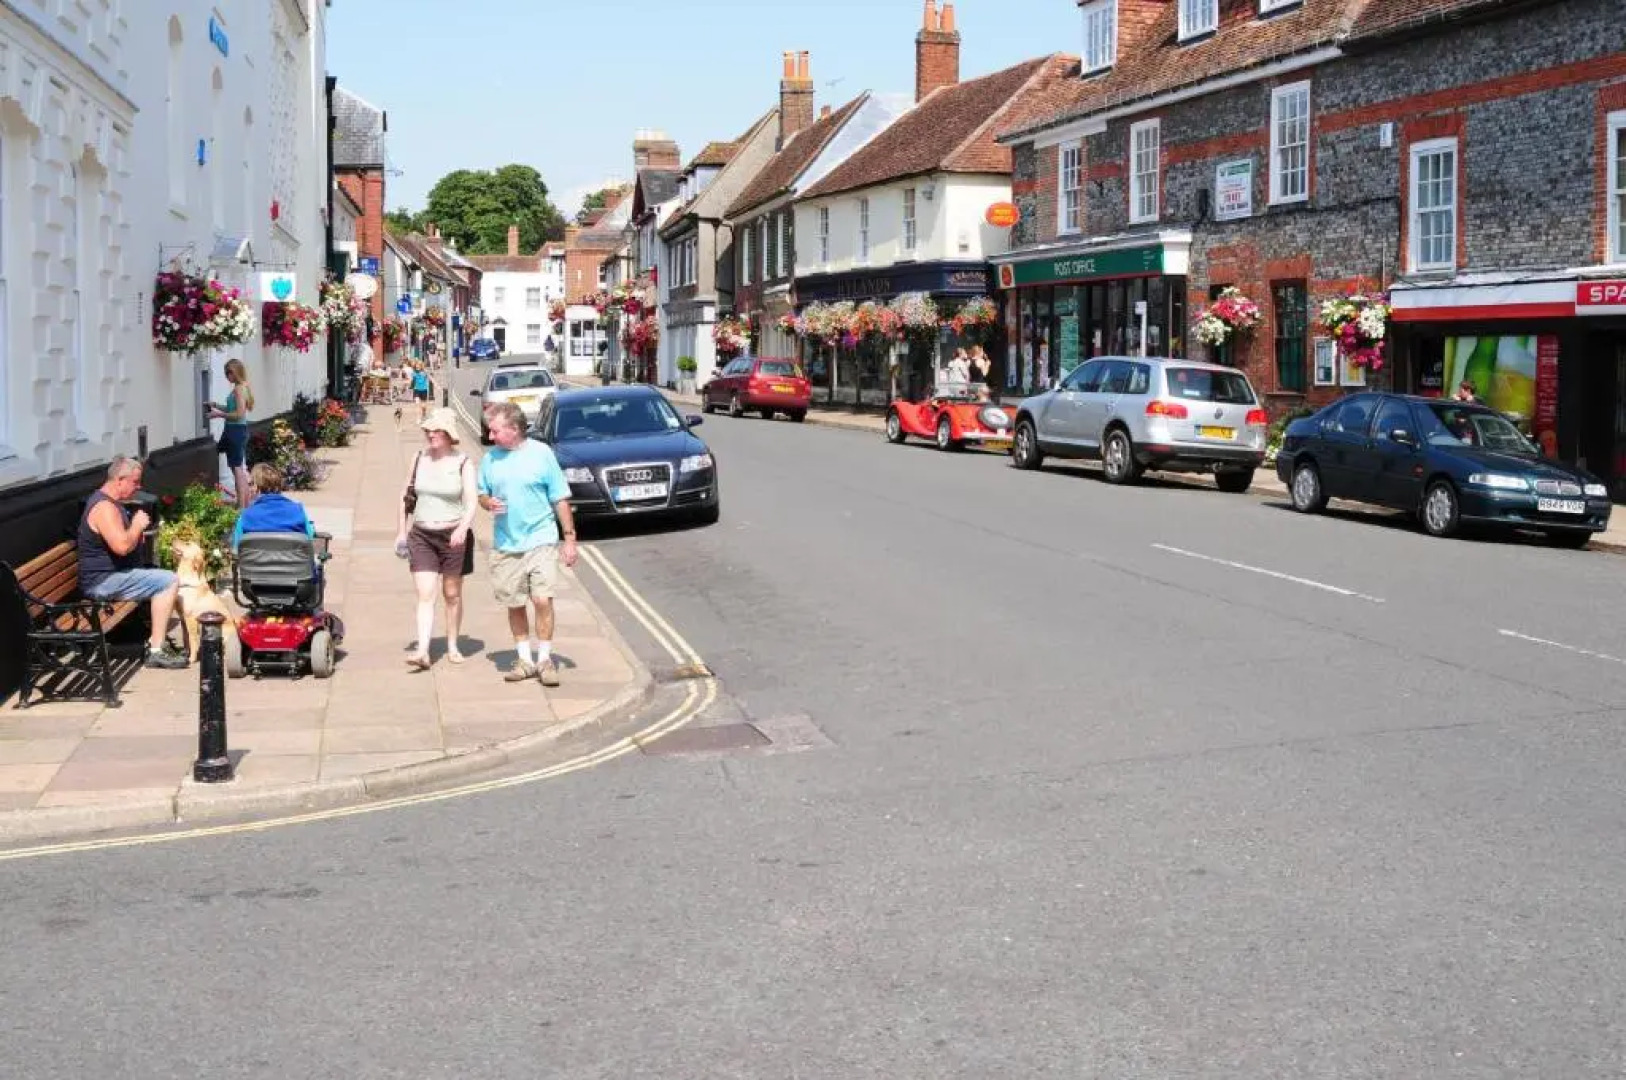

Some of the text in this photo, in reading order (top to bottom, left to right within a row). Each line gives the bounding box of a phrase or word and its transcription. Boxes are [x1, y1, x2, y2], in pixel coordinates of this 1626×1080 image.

[1054, 258, 1096, 275] POST OFFICE
[1590, 285, 1626, 302] SPA
